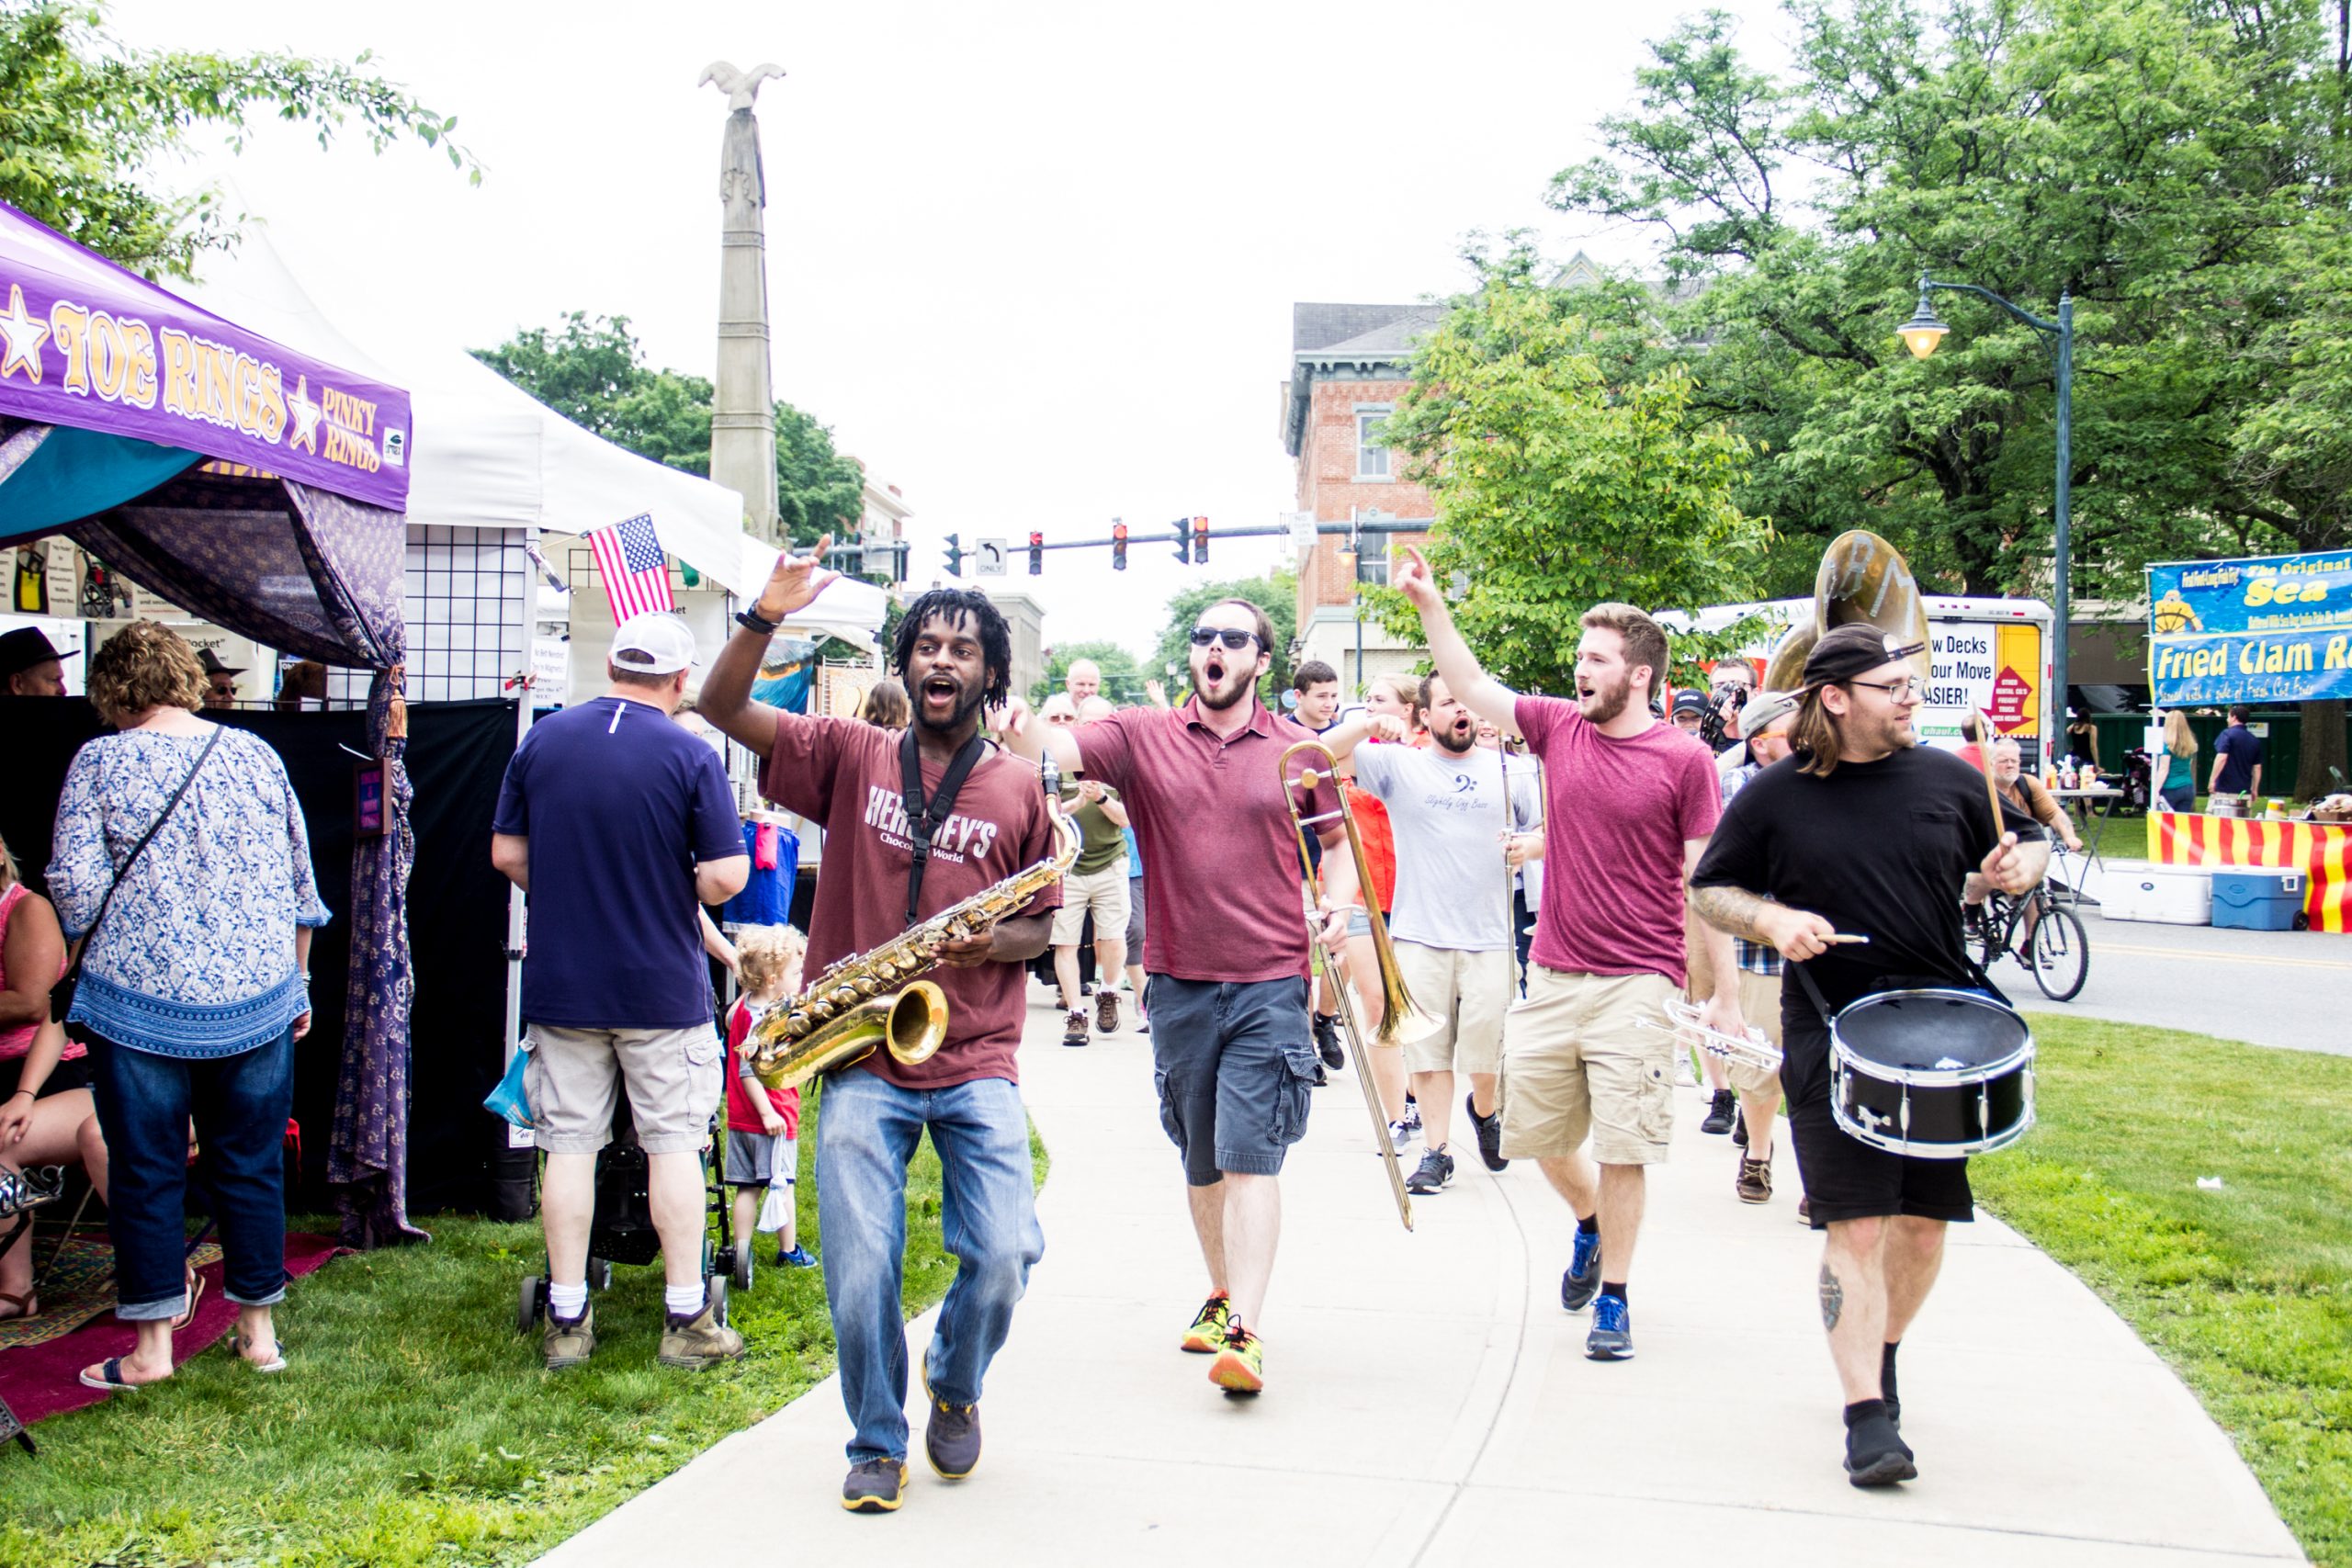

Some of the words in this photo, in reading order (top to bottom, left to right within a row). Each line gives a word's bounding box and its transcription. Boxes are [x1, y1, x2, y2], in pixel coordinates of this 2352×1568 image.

[51, 299, 158, 410] TOE
[160, 326, 288, 445] RINGS
[323, 386, 378, 436] PINKY
[325, 424, 380, 473] RINGS
[2247, 566, 2277, 577] The
[2280, 558, 2352, 575] Original
[2244, 577, 2329, 606] Sea
[1948, 637, 1986, 654] Decks
[1931, 664, 1952, 679] our
[1957, 661, 1991, 680] Move
[2156, 642, 2228, 680] Fried
[2239, 640, 2313, 675] Clam
[1925, 687, 1968, 705] ASIER!
[2246, 677, 2269, 699] Fresh
[2273, 675, 2289, 697] Cut
[1923, 727, 1963, 736] uhaul.c
[865, 785, 998, 859] HEREY'S
[933, 848, 965, 864] World
